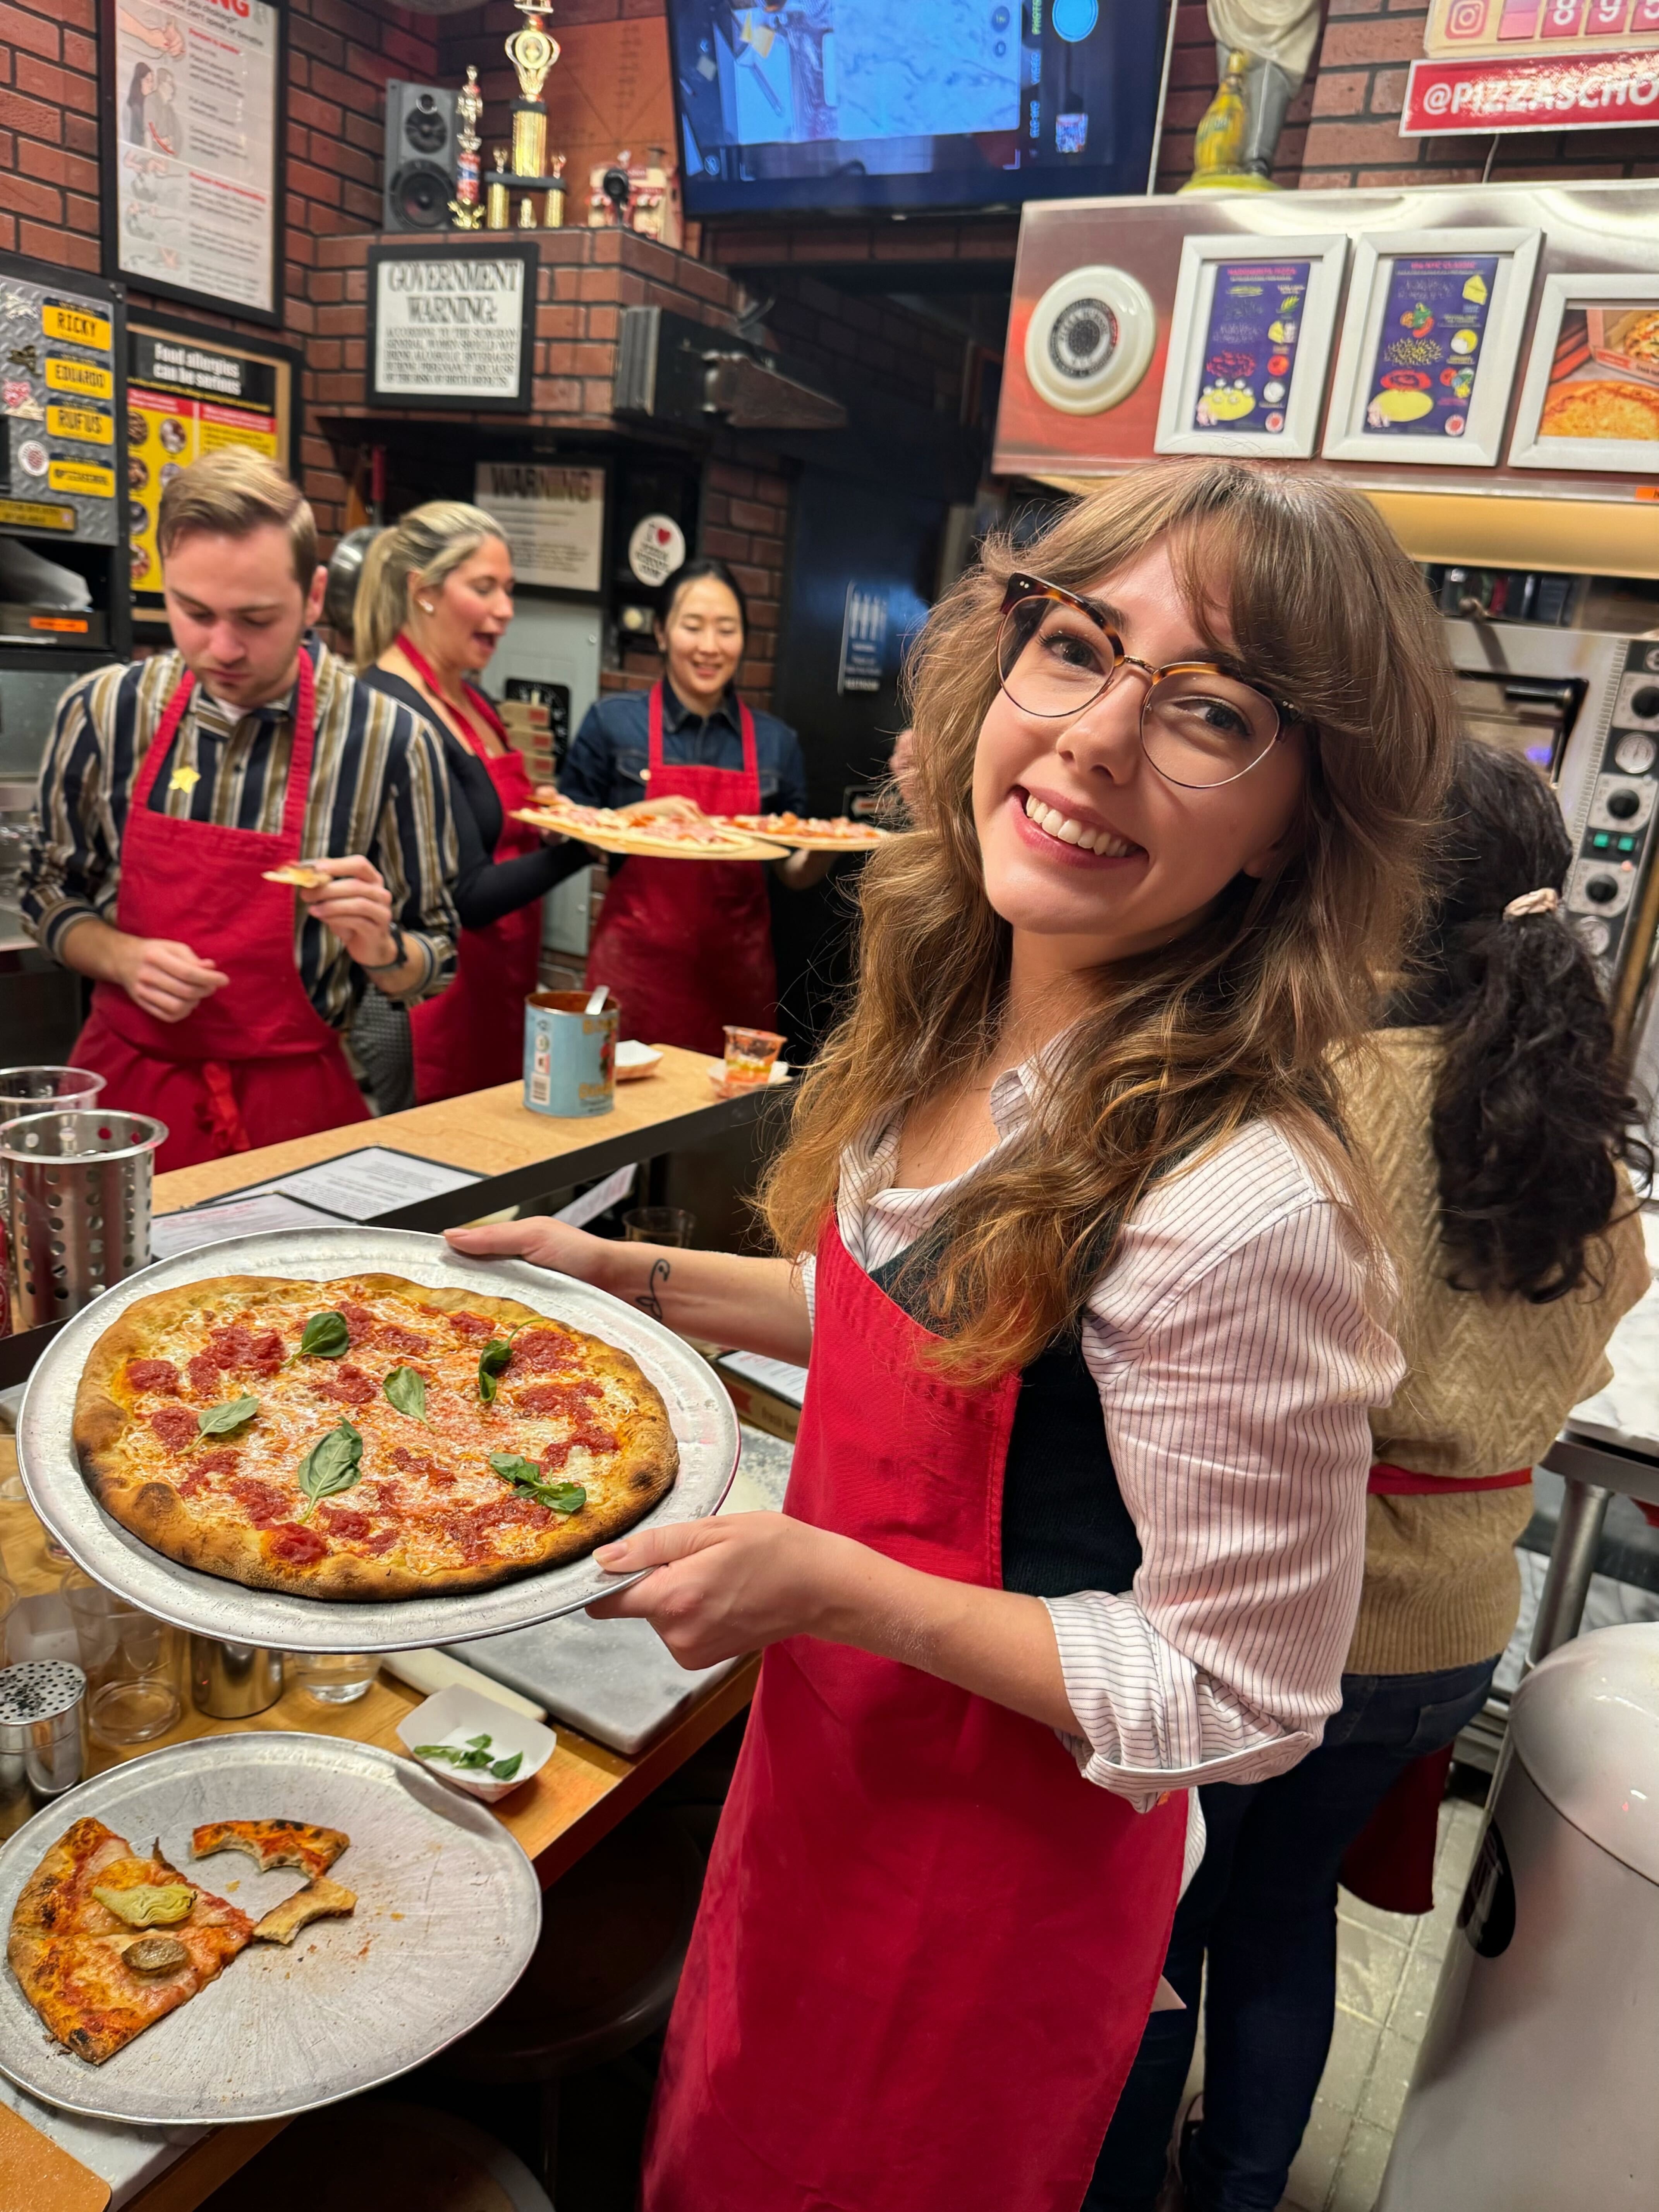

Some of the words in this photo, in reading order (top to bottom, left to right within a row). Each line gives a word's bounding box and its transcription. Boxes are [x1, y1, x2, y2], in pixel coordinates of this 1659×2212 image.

[388, 261, 518, 292] GOVERNMENT
[57, 311, 97, 338] RICKY
[154, 342, 185, 366] Food
[186, 351, 240, 378] allergies
[55, 364, 105, 389] EDUARDO
[153, 363, 179, 383] can
[179, 368, 195, 387] be
[195, 374, 241, 396] serious
[58, 409, 103, 434] RUFUS
[489, 464, 591, 503] WARNING
